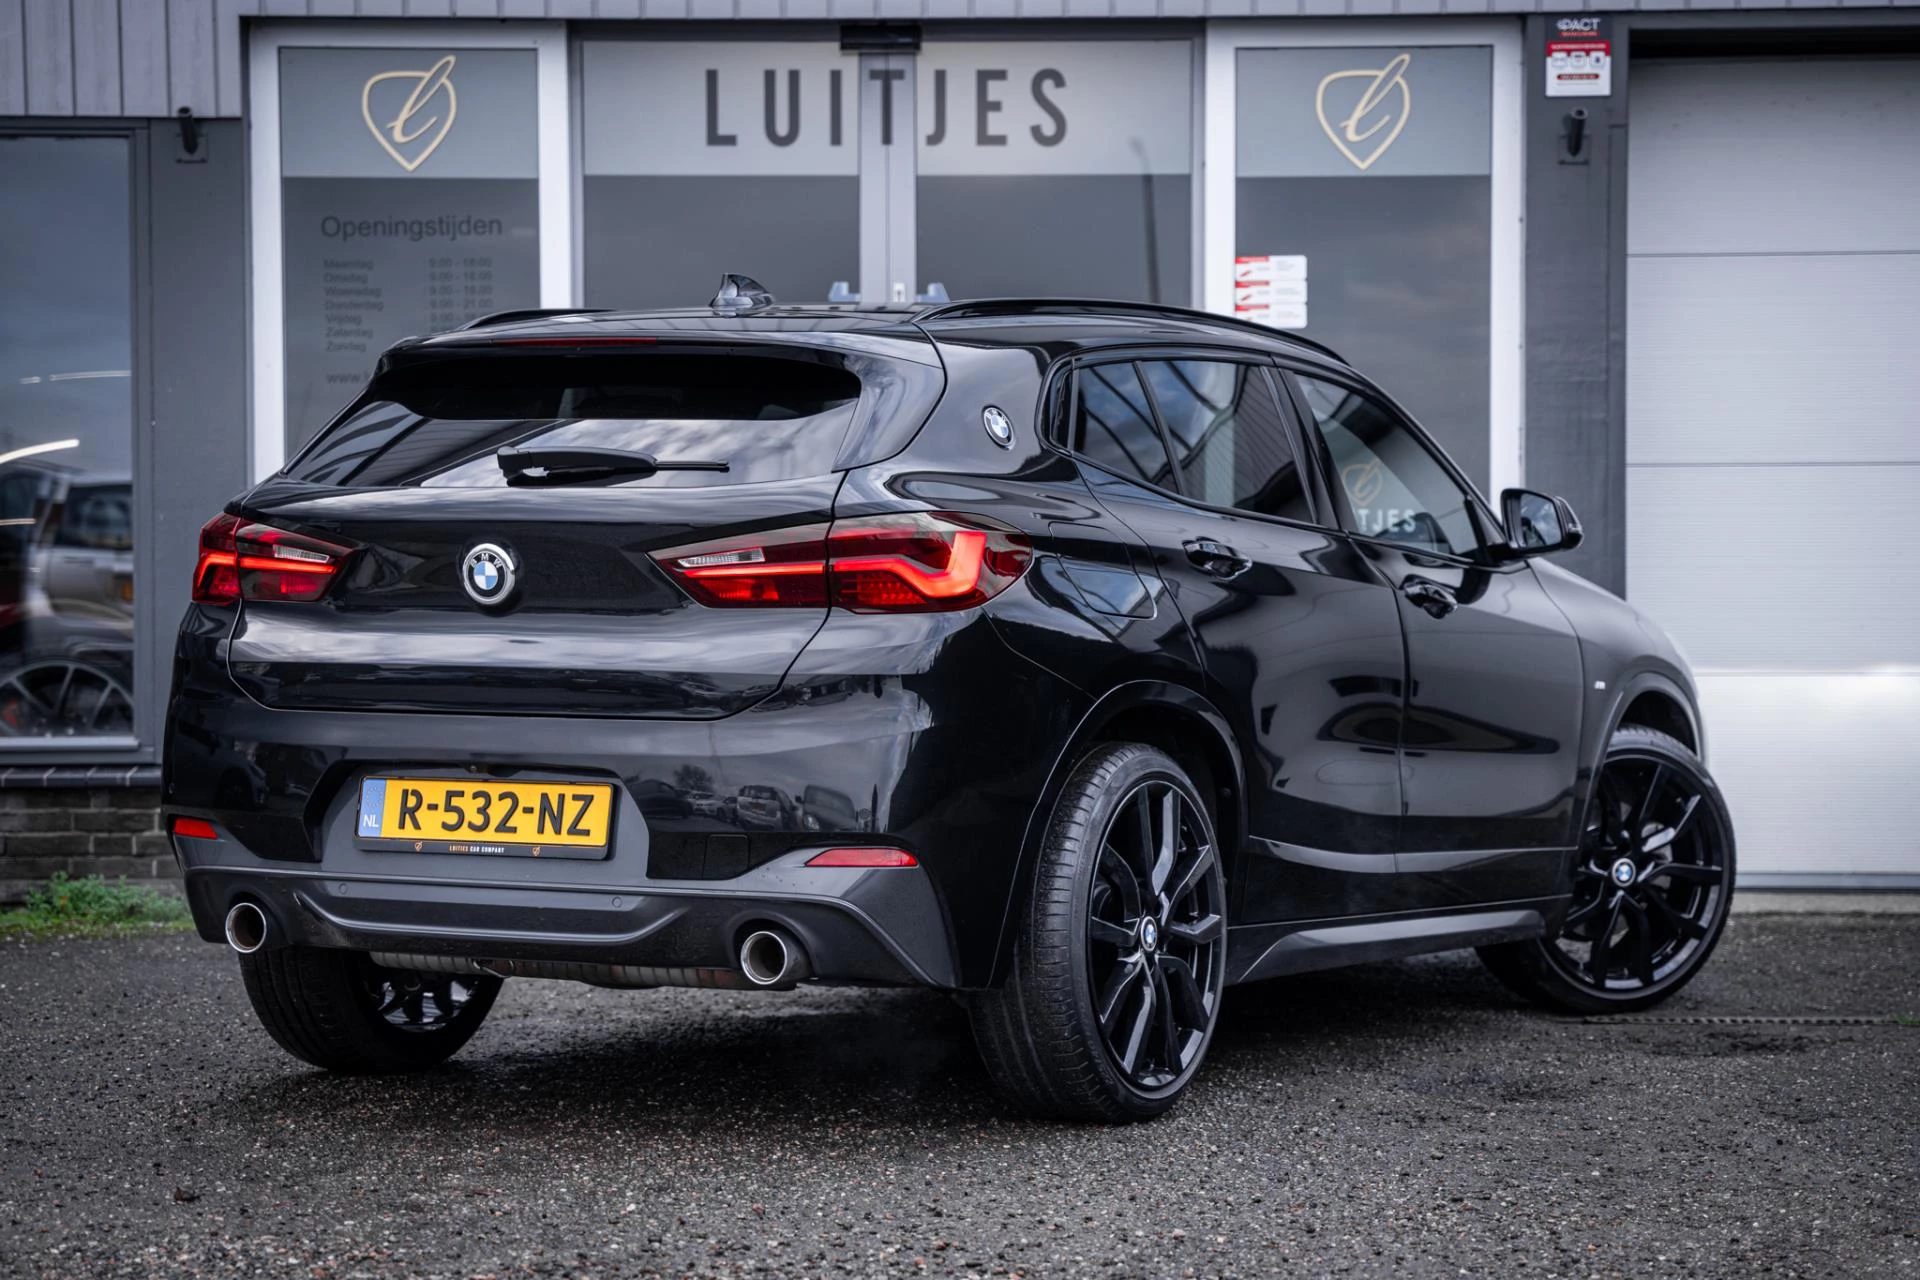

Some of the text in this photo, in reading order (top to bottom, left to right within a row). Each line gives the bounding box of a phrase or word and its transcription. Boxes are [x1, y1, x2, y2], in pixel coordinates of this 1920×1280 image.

[705, 68, 1068, 147] LUITJES
[320, 215, 503, 242] Openingstijden
[1358, 508, 1417, 533] TJES
[362, 813, 379, 829] NL
[397, 787, 595, 837] R-532-NZ
